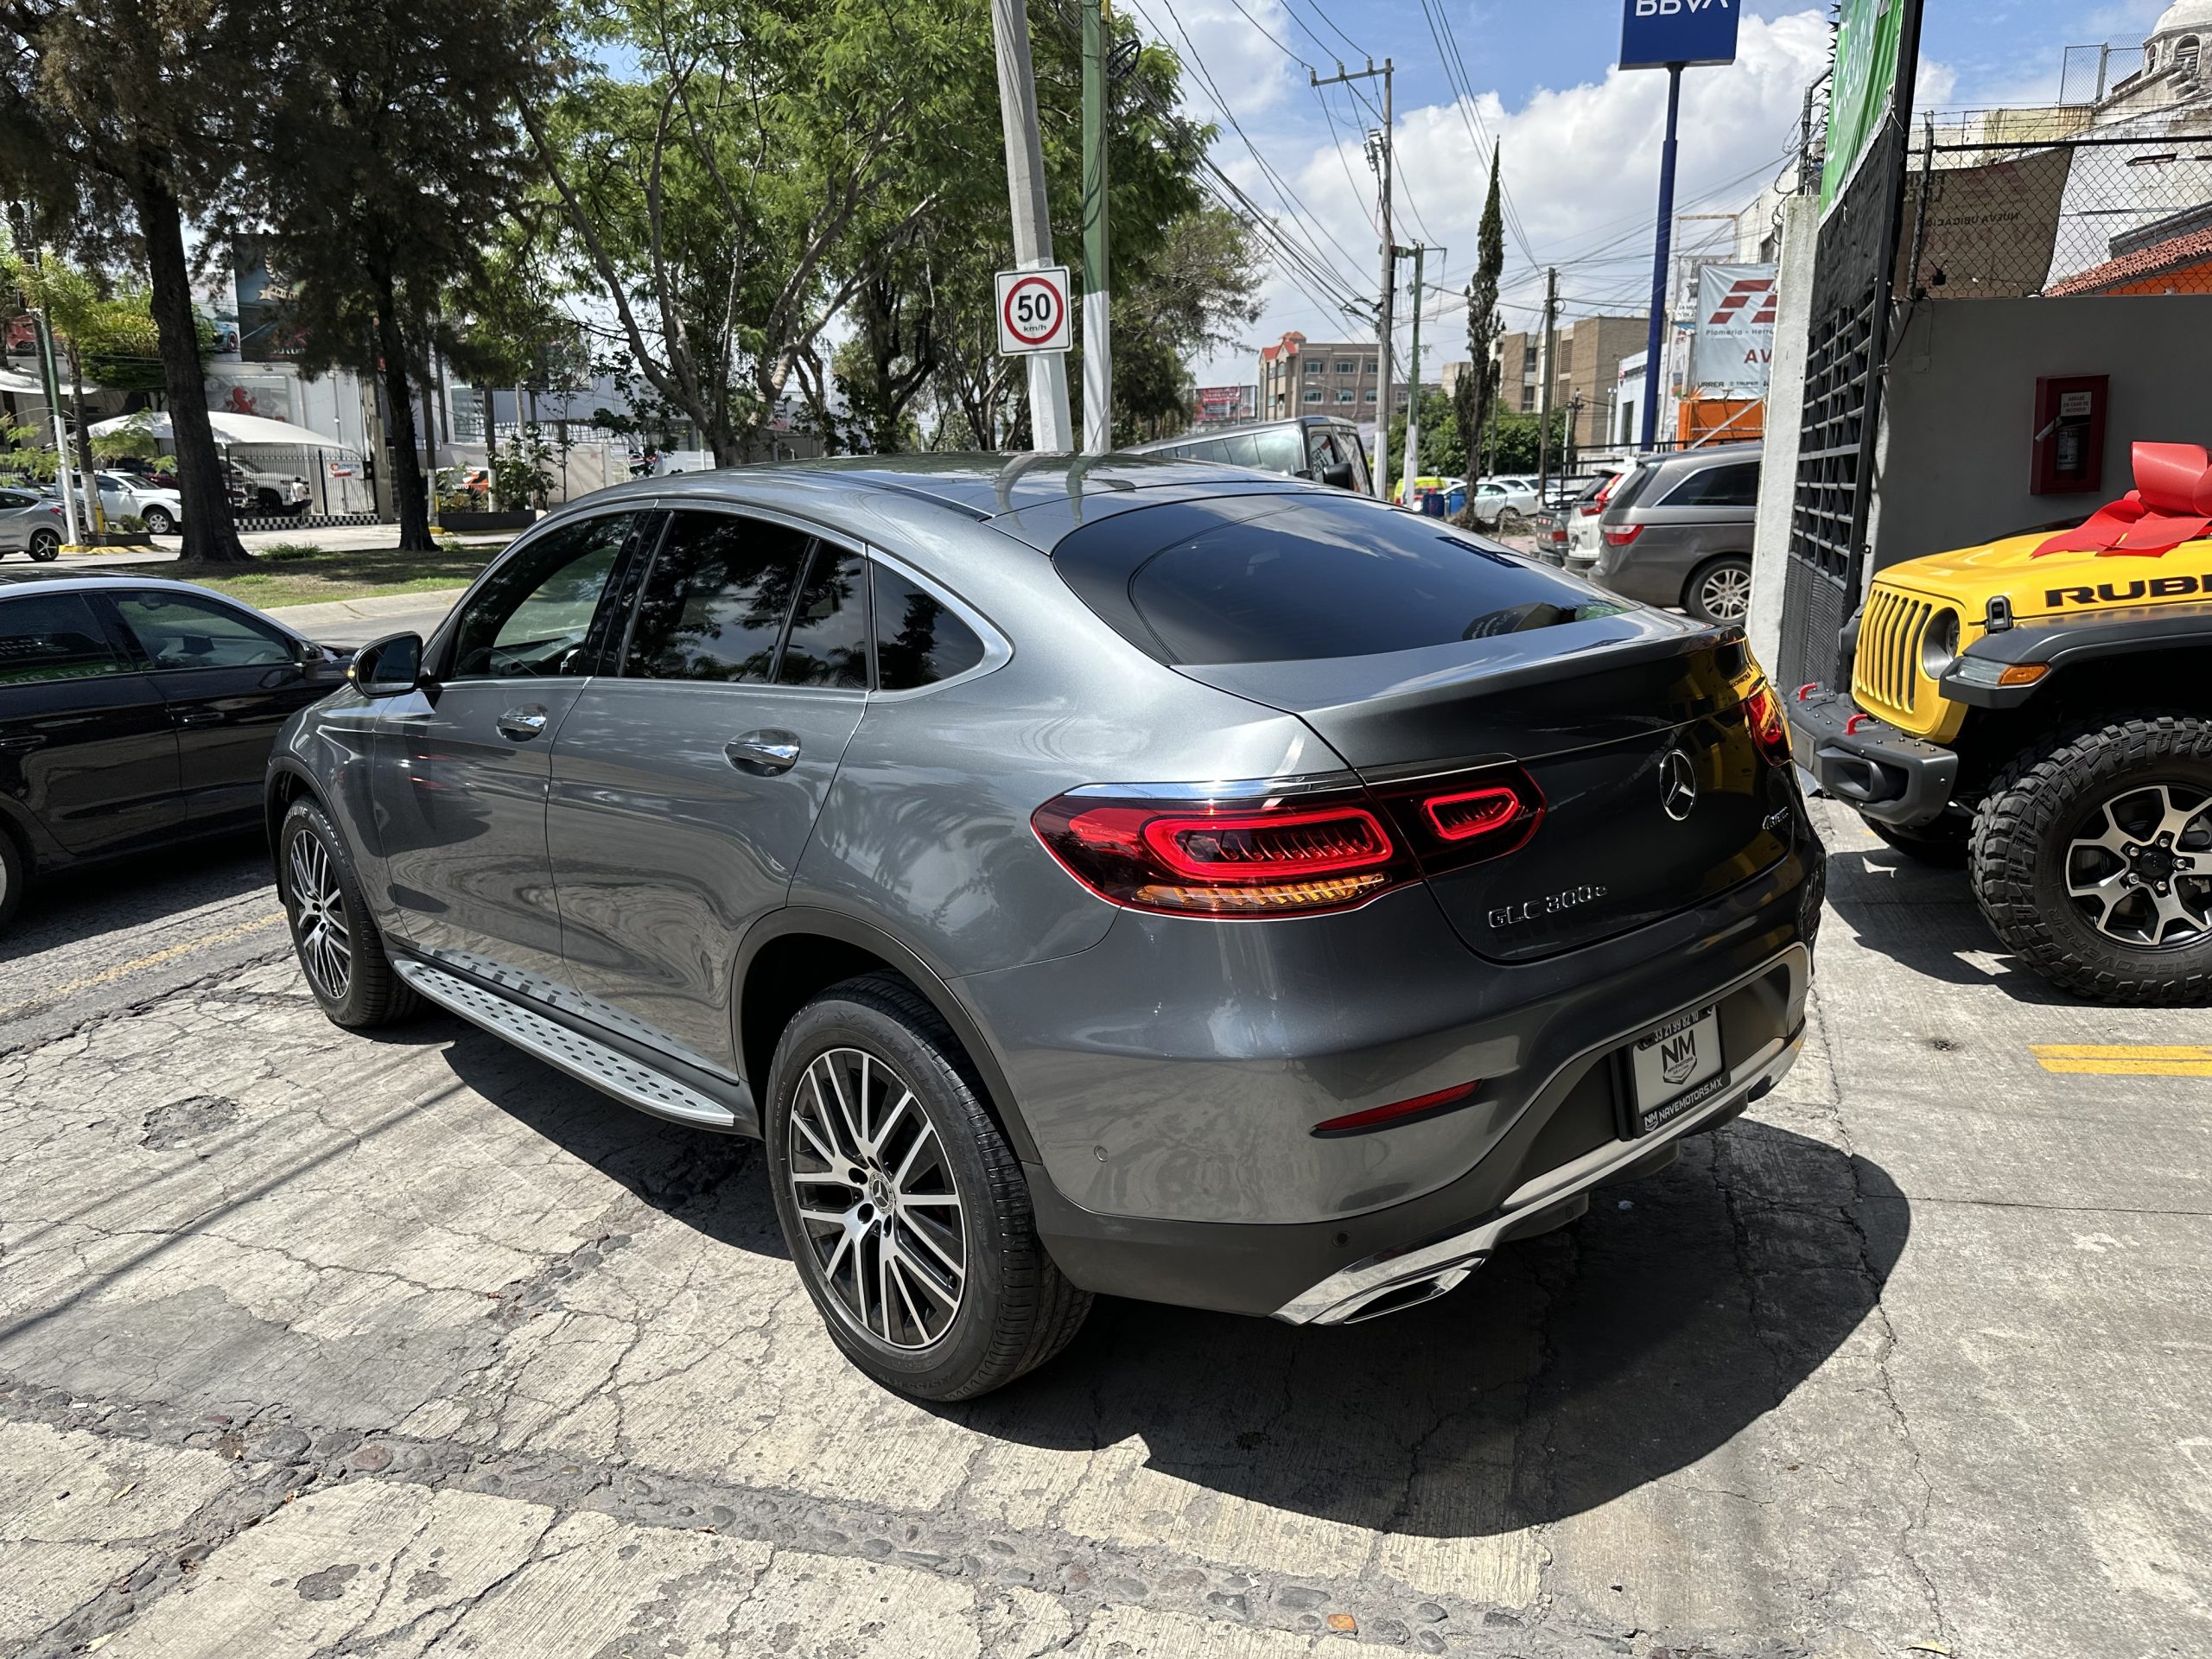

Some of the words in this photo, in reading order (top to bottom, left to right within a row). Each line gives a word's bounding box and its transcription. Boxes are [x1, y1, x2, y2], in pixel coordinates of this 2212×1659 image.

[1018, 293, 1051, 322] 50
[1489, 899, 1541, 928] GLC
[1654, 1027, 1663, 1042] 33
[1664, 1023, 1672, 1037] 21
[1672, 1019, 1681, 1033] 99
[1661, 1029, 1696, 1074] NM
[1659, 1077, 1723, 1122] NAVEMOTORS.MX
